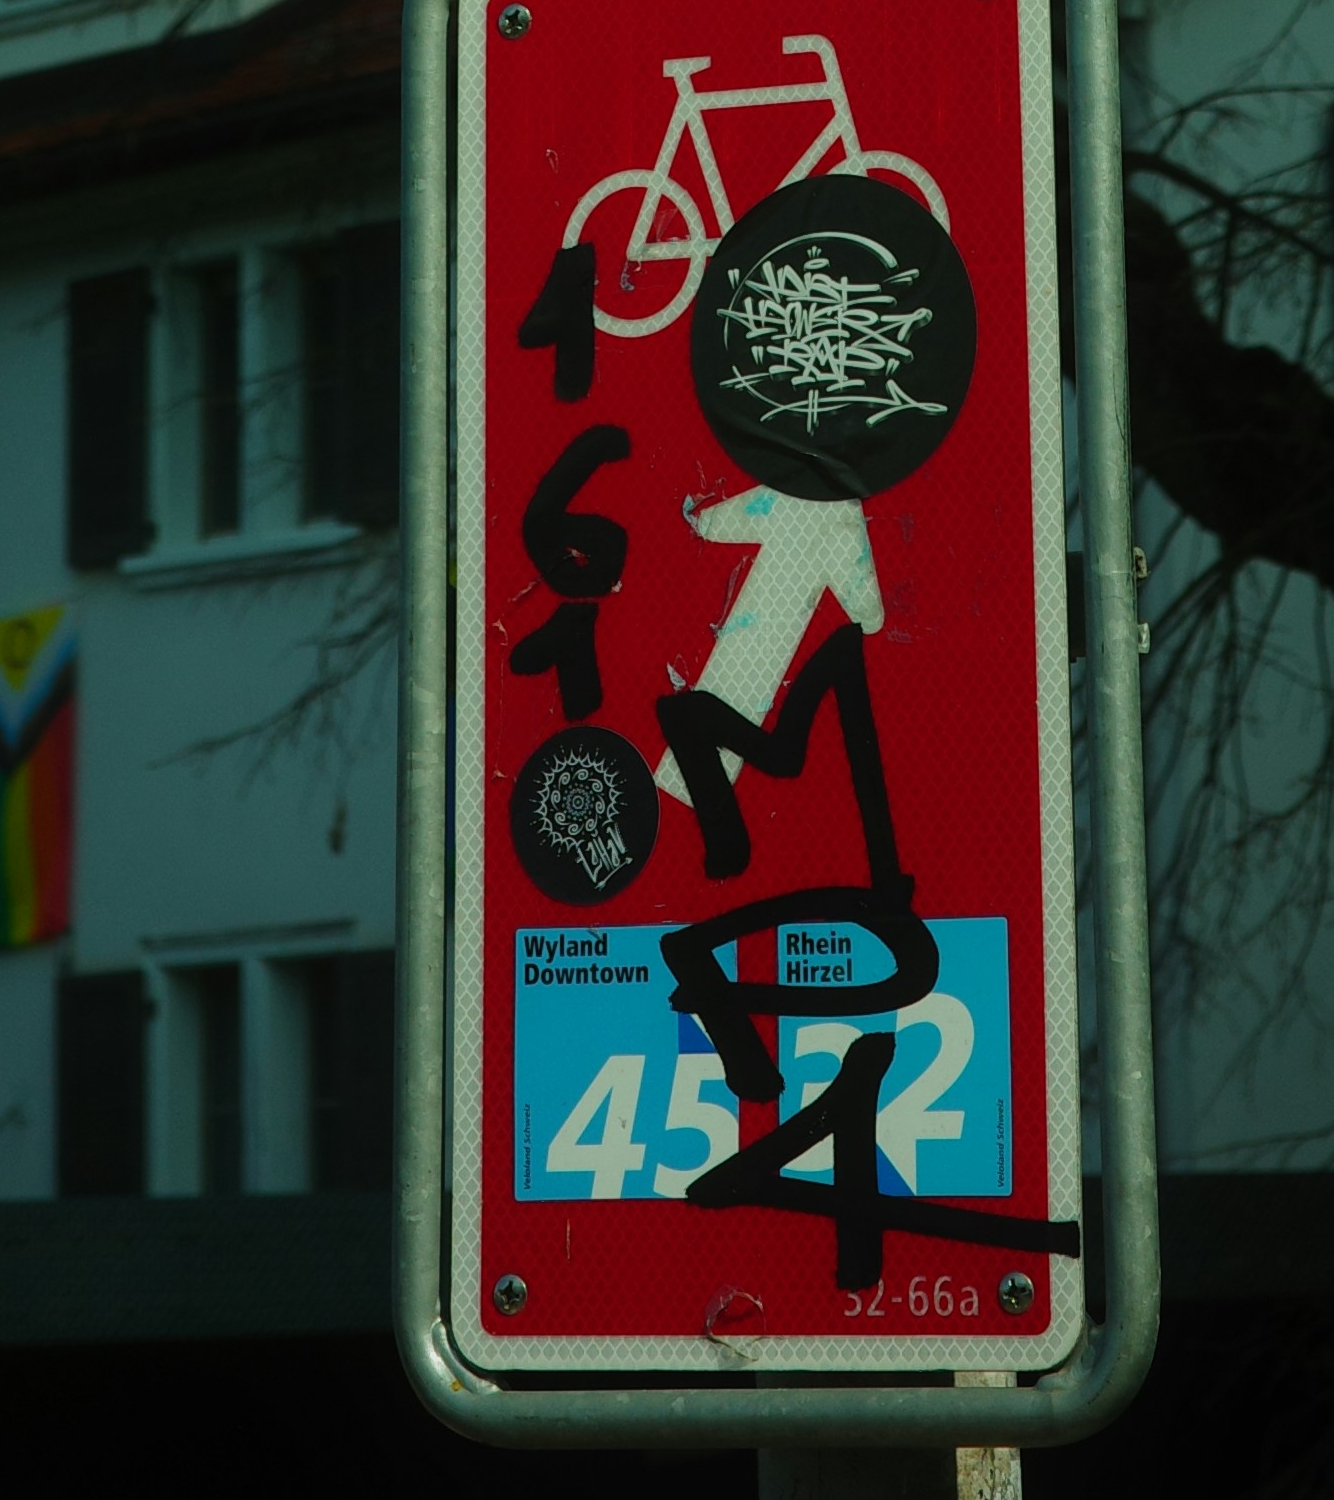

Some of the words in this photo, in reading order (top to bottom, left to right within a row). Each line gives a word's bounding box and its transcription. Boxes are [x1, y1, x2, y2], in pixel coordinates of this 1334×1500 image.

[523, 933, 609, 960] Wyland
[785, 932, 852, 956] Rhein
[523, 960, 650, 986] Downtown
[785, 959, 854, 984] Hirzel
